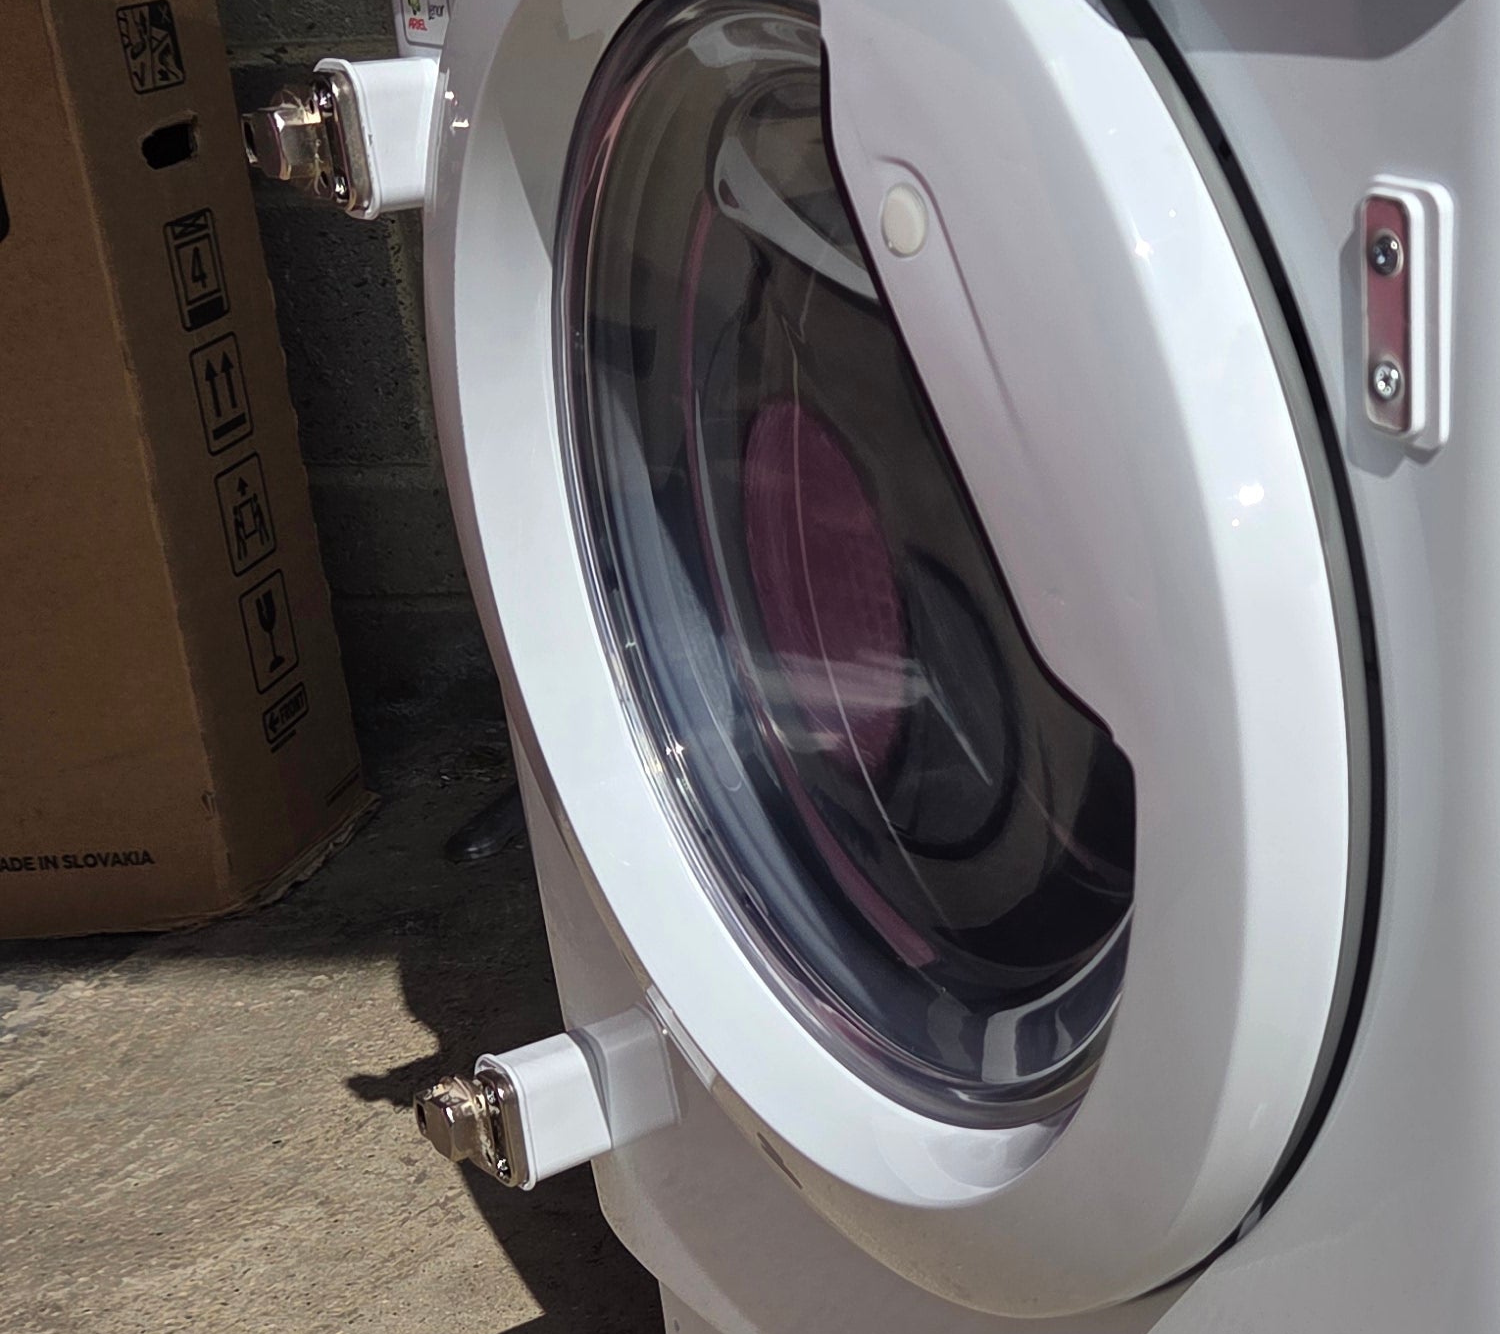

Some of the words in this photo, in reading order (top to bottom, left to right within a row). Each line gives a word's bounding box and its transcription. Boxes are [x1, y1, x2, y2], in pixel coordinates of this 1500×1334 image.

[190, 244, 208, 289] 4
[280, 690, 305, 724] FRONT
[0, 856, 36, 872] ADE
[38, 855, 58, 870] IN
[61, 850, 156, 869] SLOVAKIA
